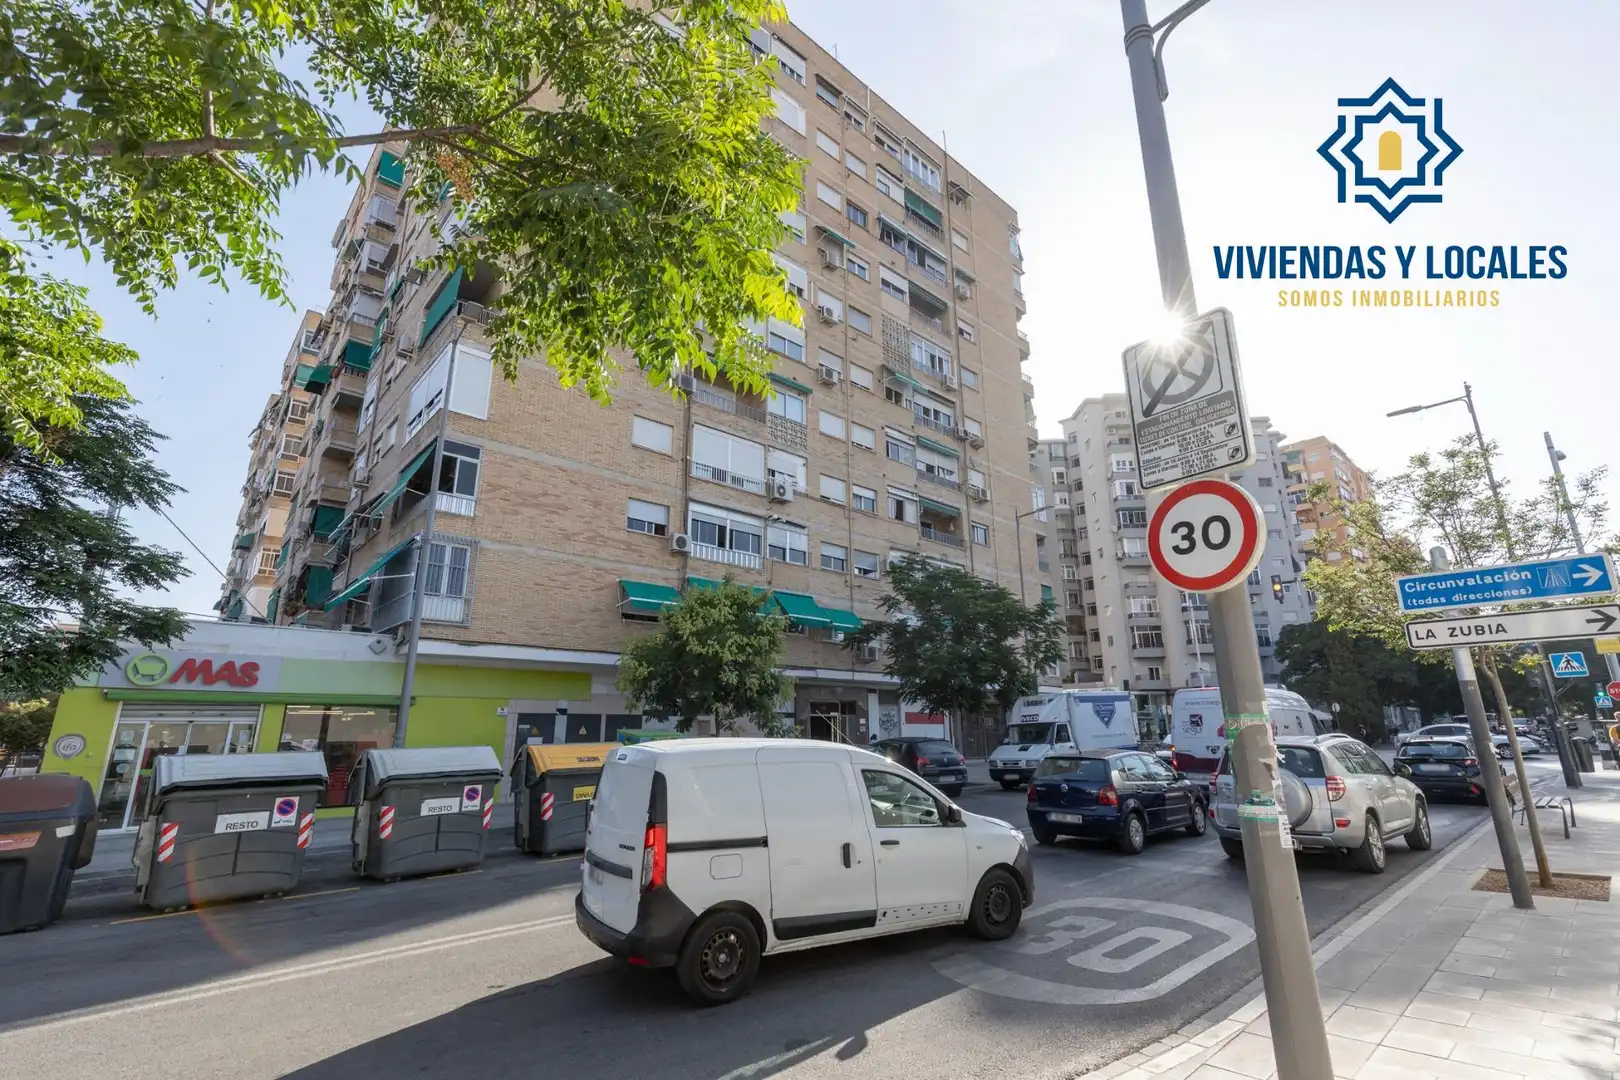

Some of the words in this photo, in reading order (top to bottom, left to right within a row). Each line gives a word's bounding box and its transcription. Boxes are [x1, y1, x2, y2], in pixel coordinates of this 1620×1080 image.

[1140, 411, 1197, 435] ESTACIONAMIENTO
[1198, 399, 1230, 415] LIMITADO
[1159, 413, 1169, 421] FIN
[1170, 410, 1178, 418] DE
[1180, 403, 1197, 414] ZONA
[1199, 400, 1208, 408] DE
[1195, 406, 1235, 424] OBLIGATORIO
[1171, 515, 1231, 555] 30
[1404, 570, 1532, 593] Circunvalación
[1408, 597, 1446, 606] (todas
[1452, 586, 1532, 603] direcciones)
[1414, 629, 1437, 641] LA
[1447, 623, 1508, 638] ZUBIA
[169, 658, 261, 687] MAS
[1021, 714, 1039, 722] IVECO
[427, 804, 453, 813] RESTO
[225, 820, 259, 831] RESTO
